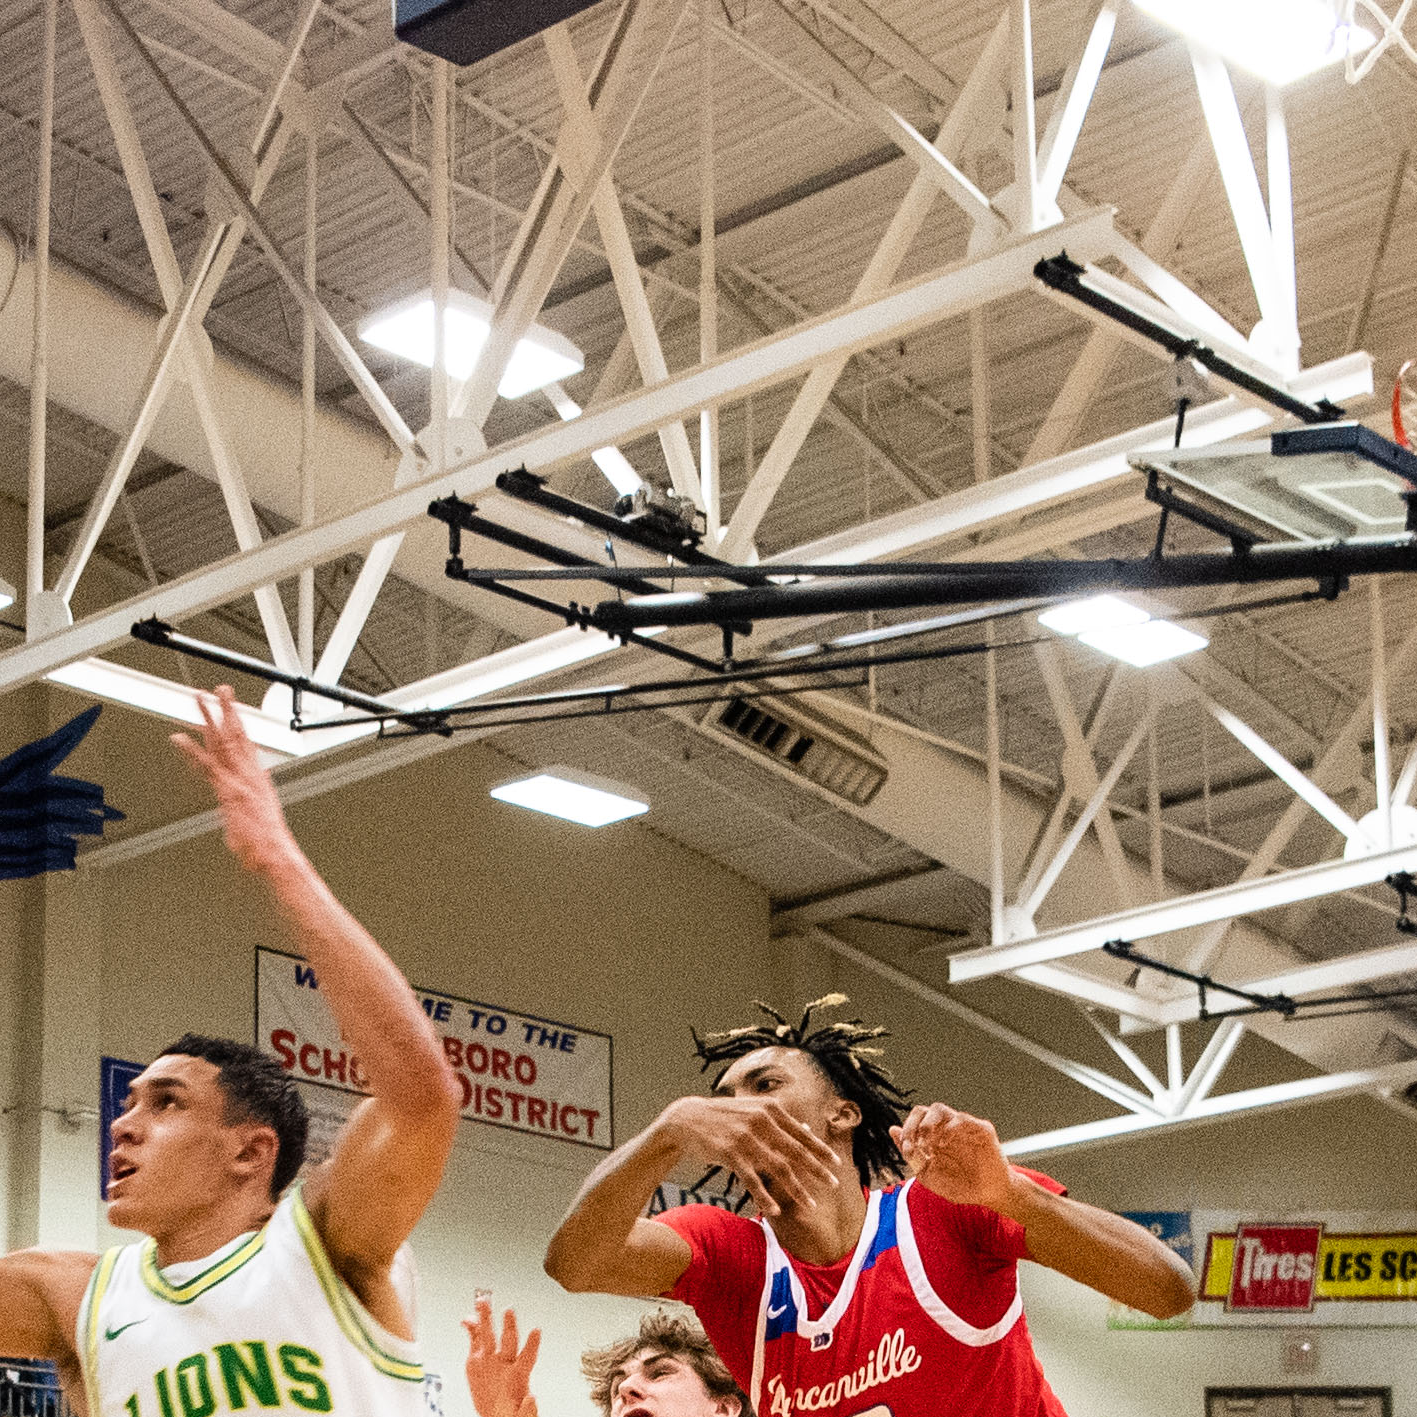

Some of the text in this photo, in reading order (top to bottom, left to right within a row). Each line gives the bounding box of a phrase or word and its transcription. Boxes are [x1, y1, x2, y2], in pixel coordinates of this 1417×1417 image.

[468, 1010, 507, 1035] TO
[522, 1023, 577, 1053] THE
[1239, 1238, 1313, 1289] Tires
[1323, 1250, 1372, 1282] LES
